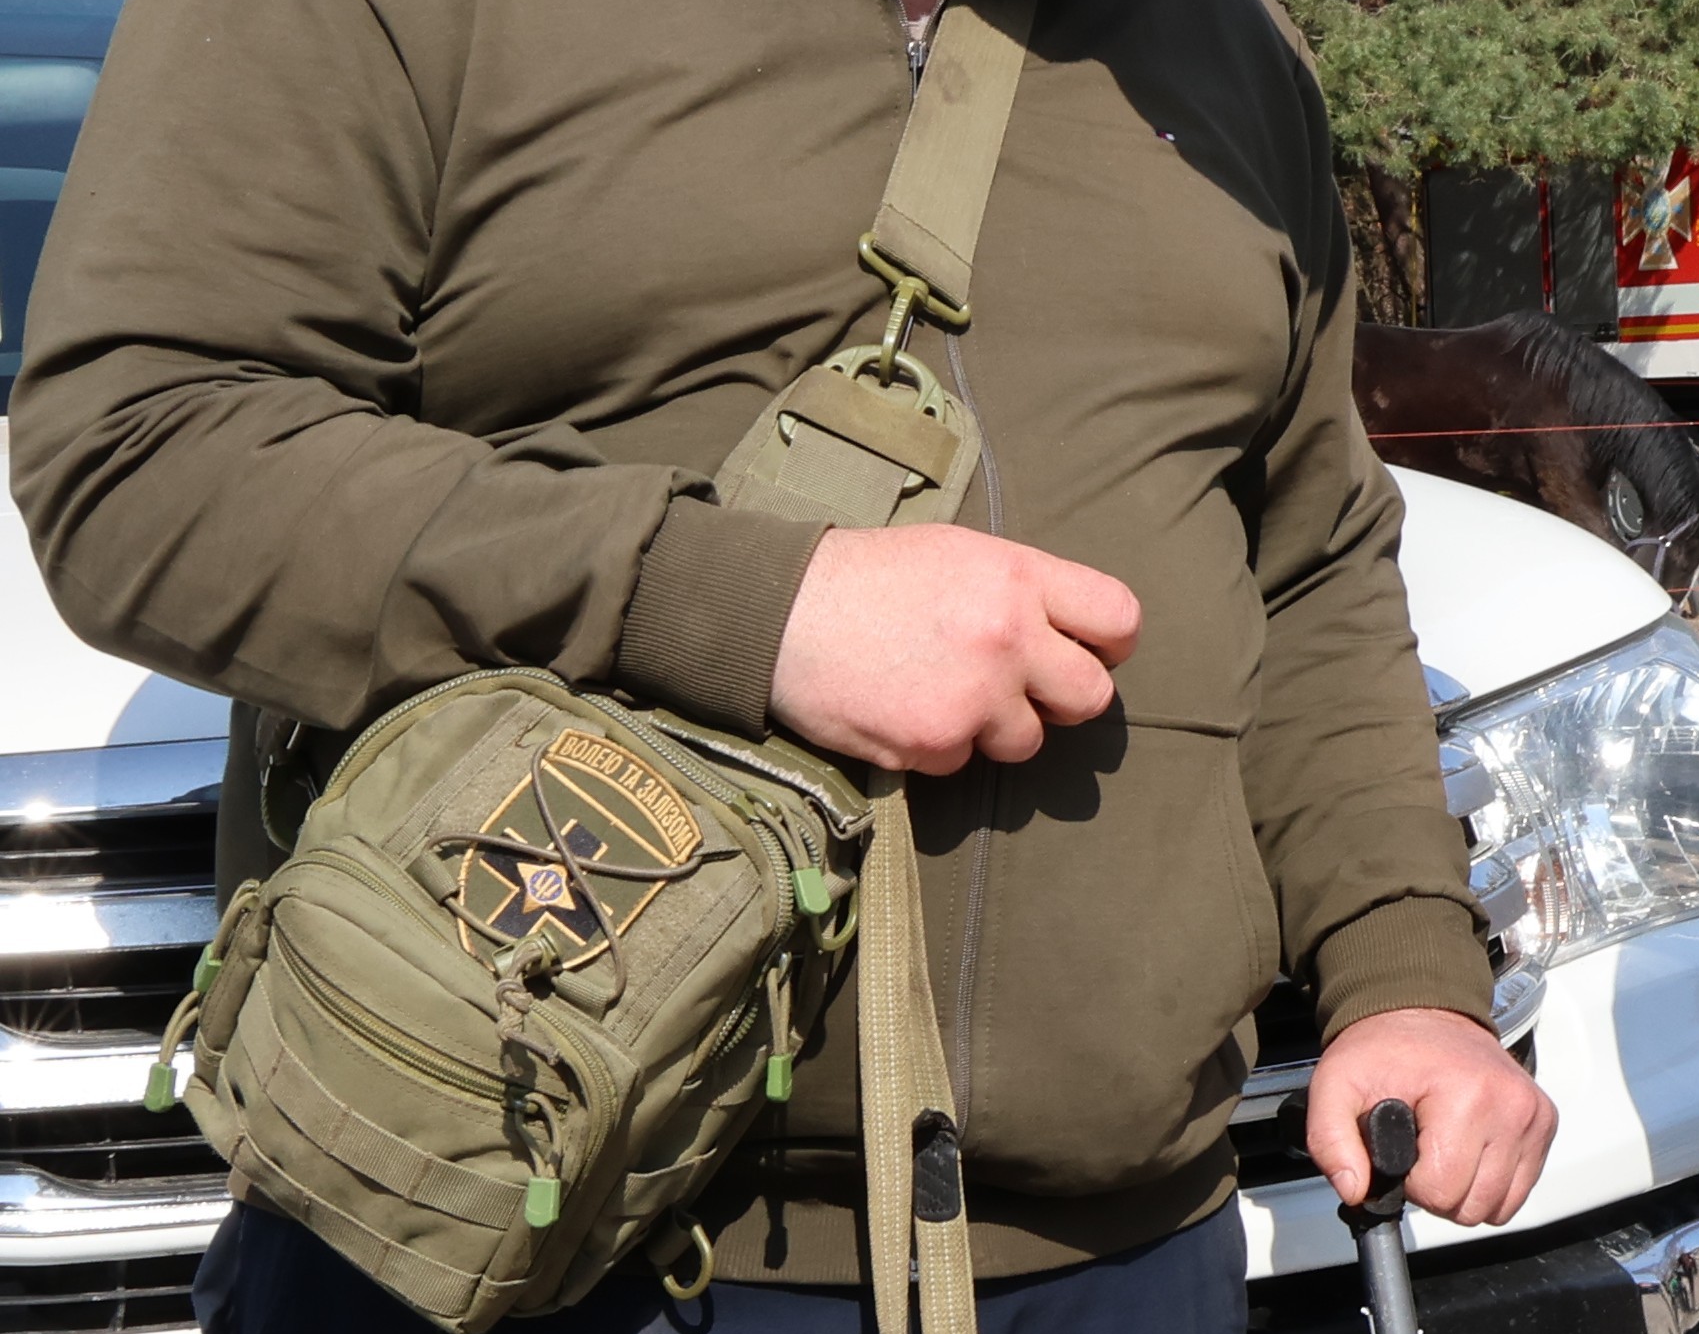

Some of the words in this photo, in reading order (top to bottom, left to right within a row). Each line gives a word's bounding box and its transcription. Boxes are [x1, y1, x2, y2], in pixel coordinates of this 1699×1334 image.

[560, 737, 624, 775] ВОЛЕЮ
[618, 763, 644, 790] ТА
[635, 777, 694, 852] ЗАЛІЗОМ
